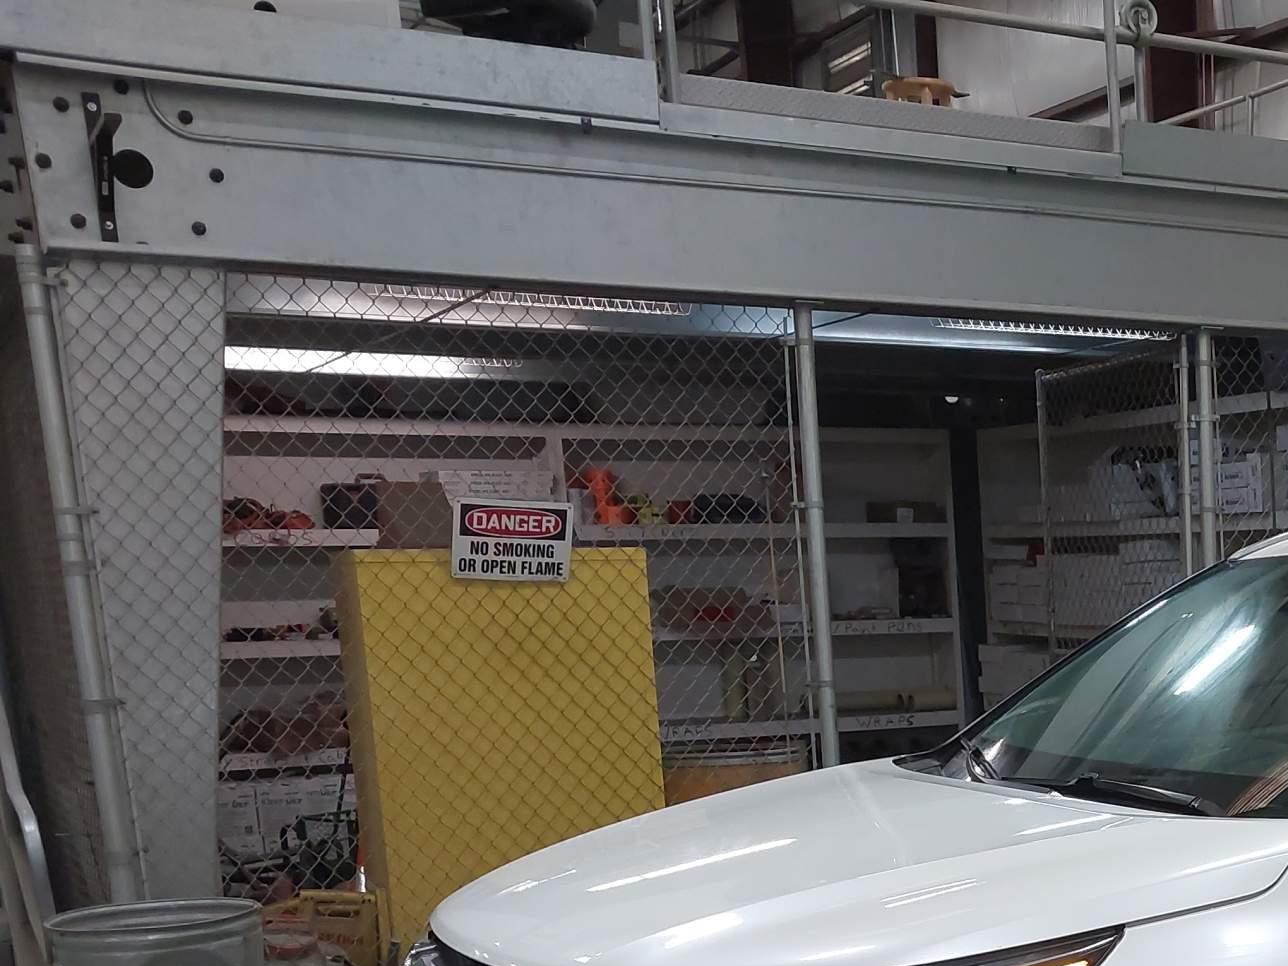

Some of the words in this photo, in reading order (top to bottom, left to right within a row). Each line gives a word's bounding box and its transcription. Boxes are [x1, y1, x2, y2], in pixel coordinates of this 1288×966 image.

[472, 512, 556, 532] DANGER
[470, 541, 489, 555] NO
[493, 541, 555, 558] SMOKING
[458, 558, 476, 573] OR
[481, 559, 517, 575] OPEN
[520, 561, 564, 576] FLAME
